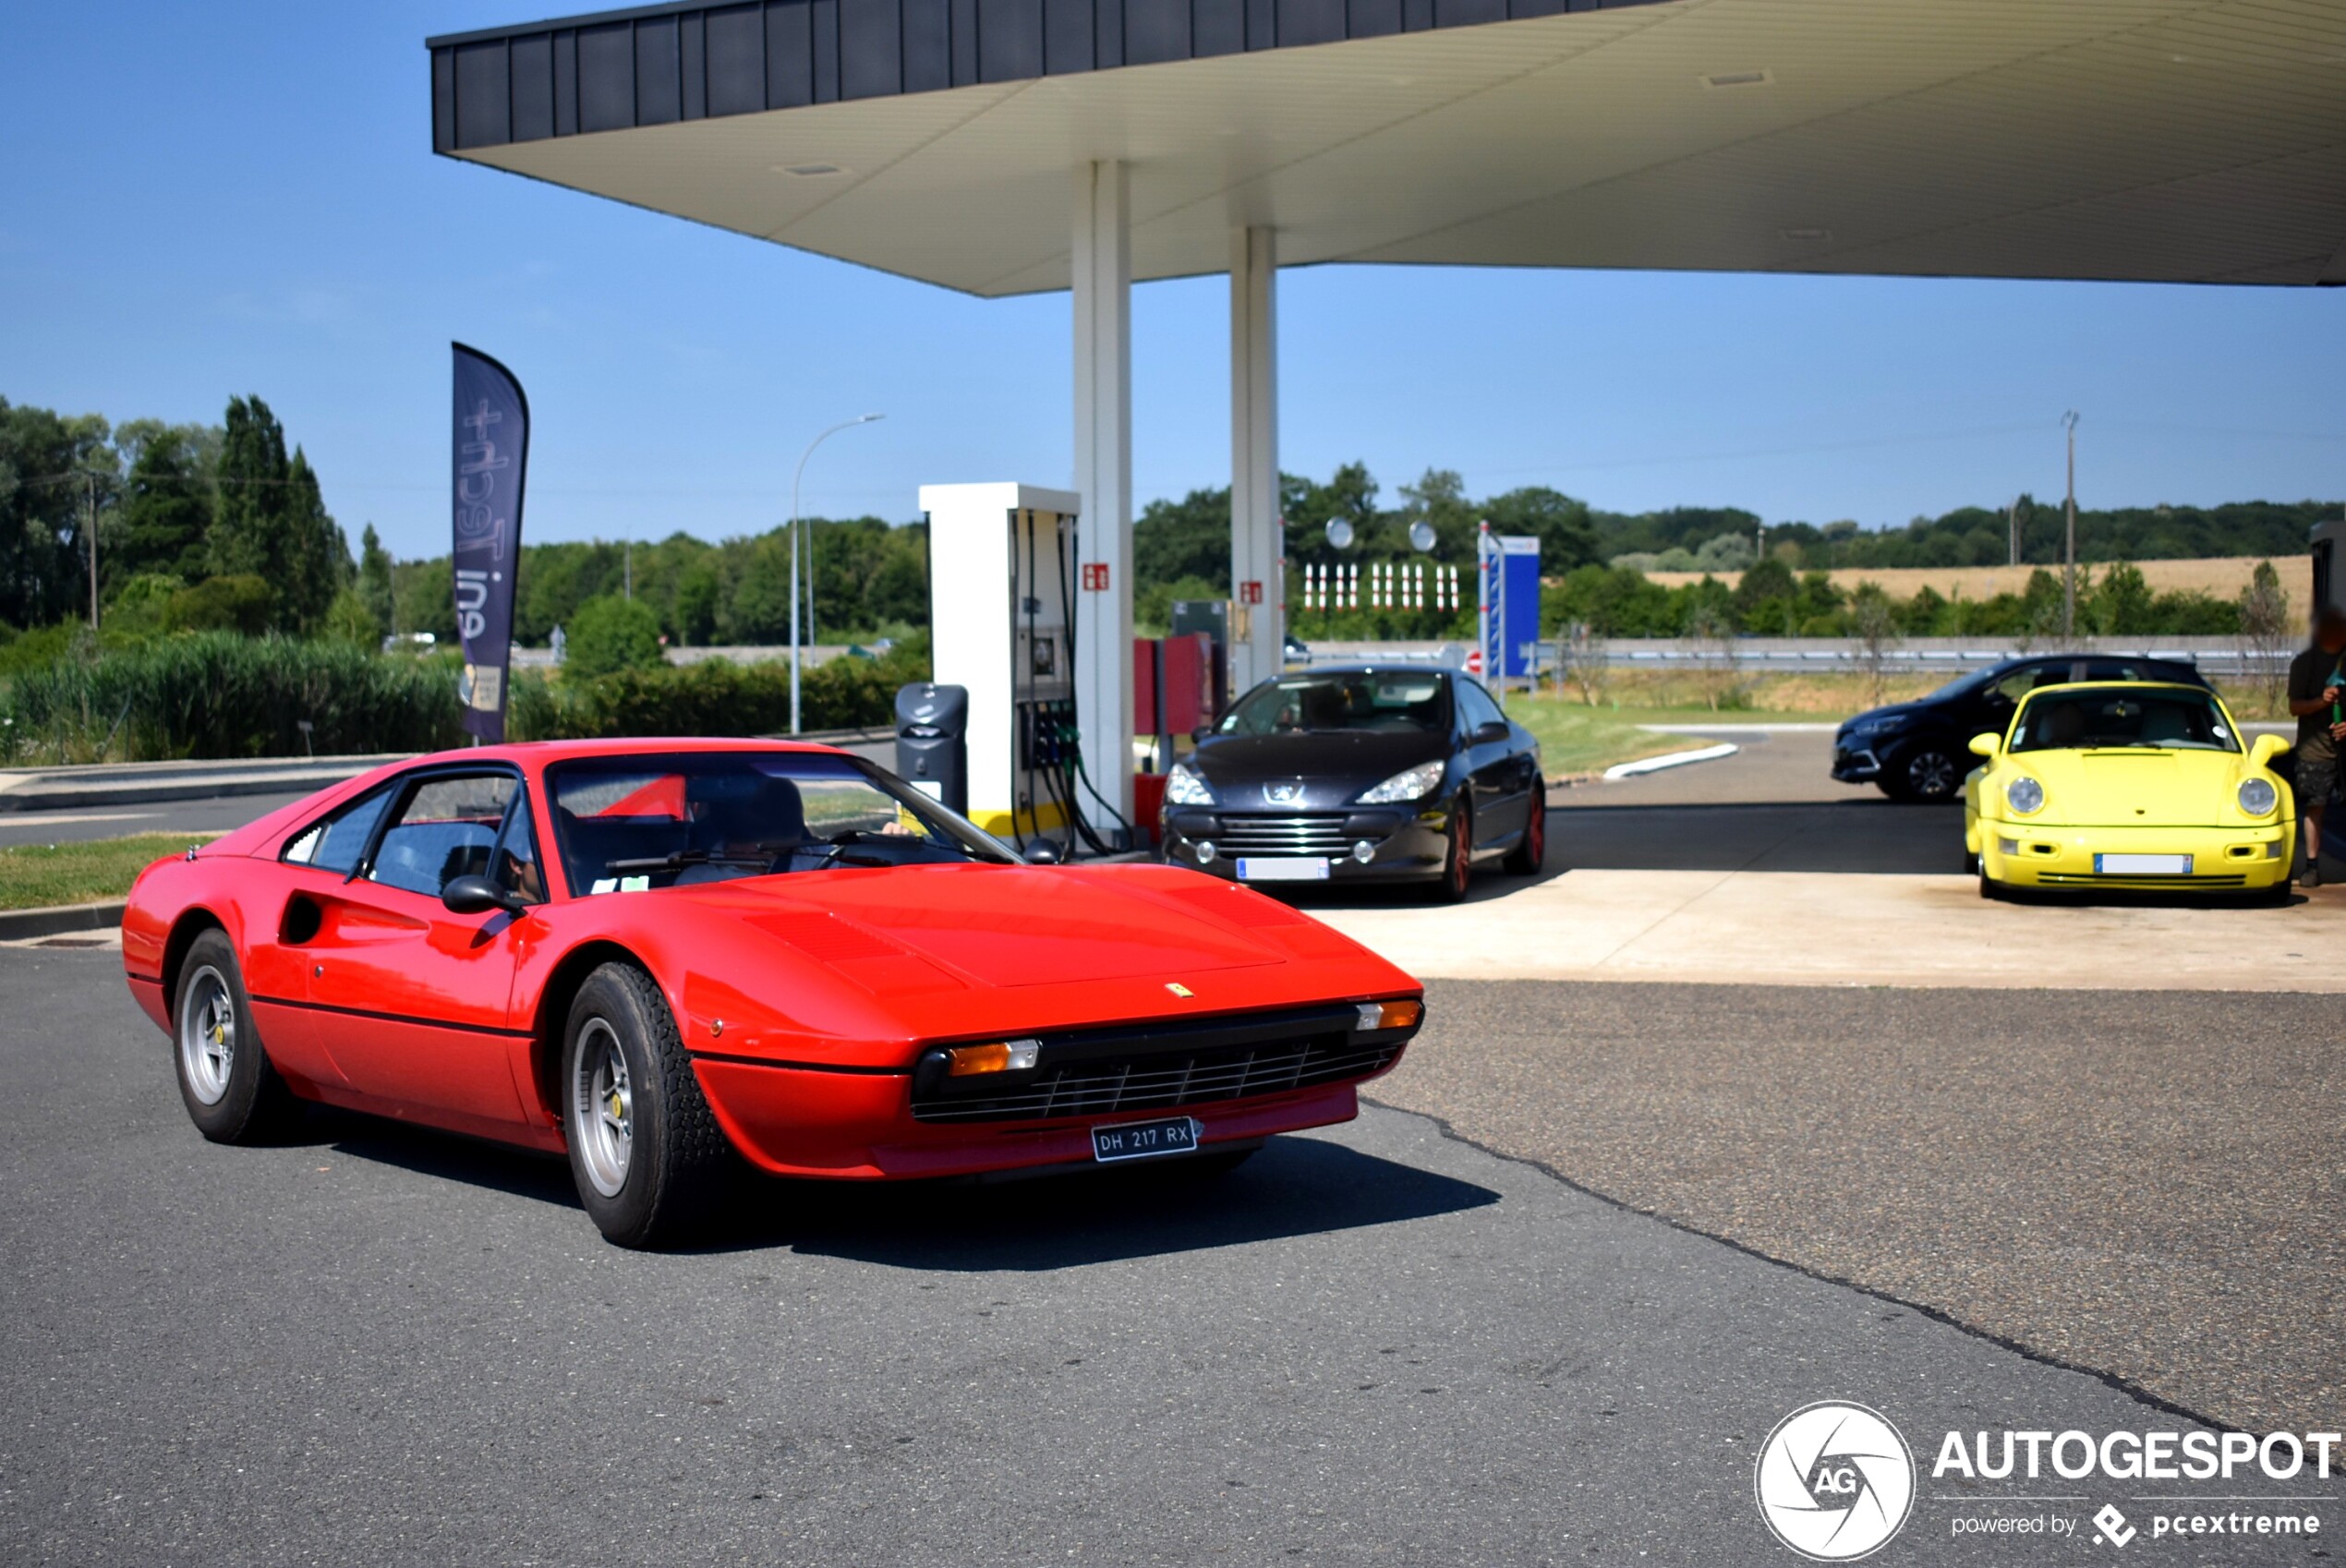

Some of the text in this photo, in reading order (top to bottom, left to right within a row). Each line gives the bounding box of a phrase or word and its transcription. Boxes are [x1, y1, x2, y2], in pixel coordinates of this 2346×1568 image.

[1100, 1126, 1189, 1151] DH 217 RX
